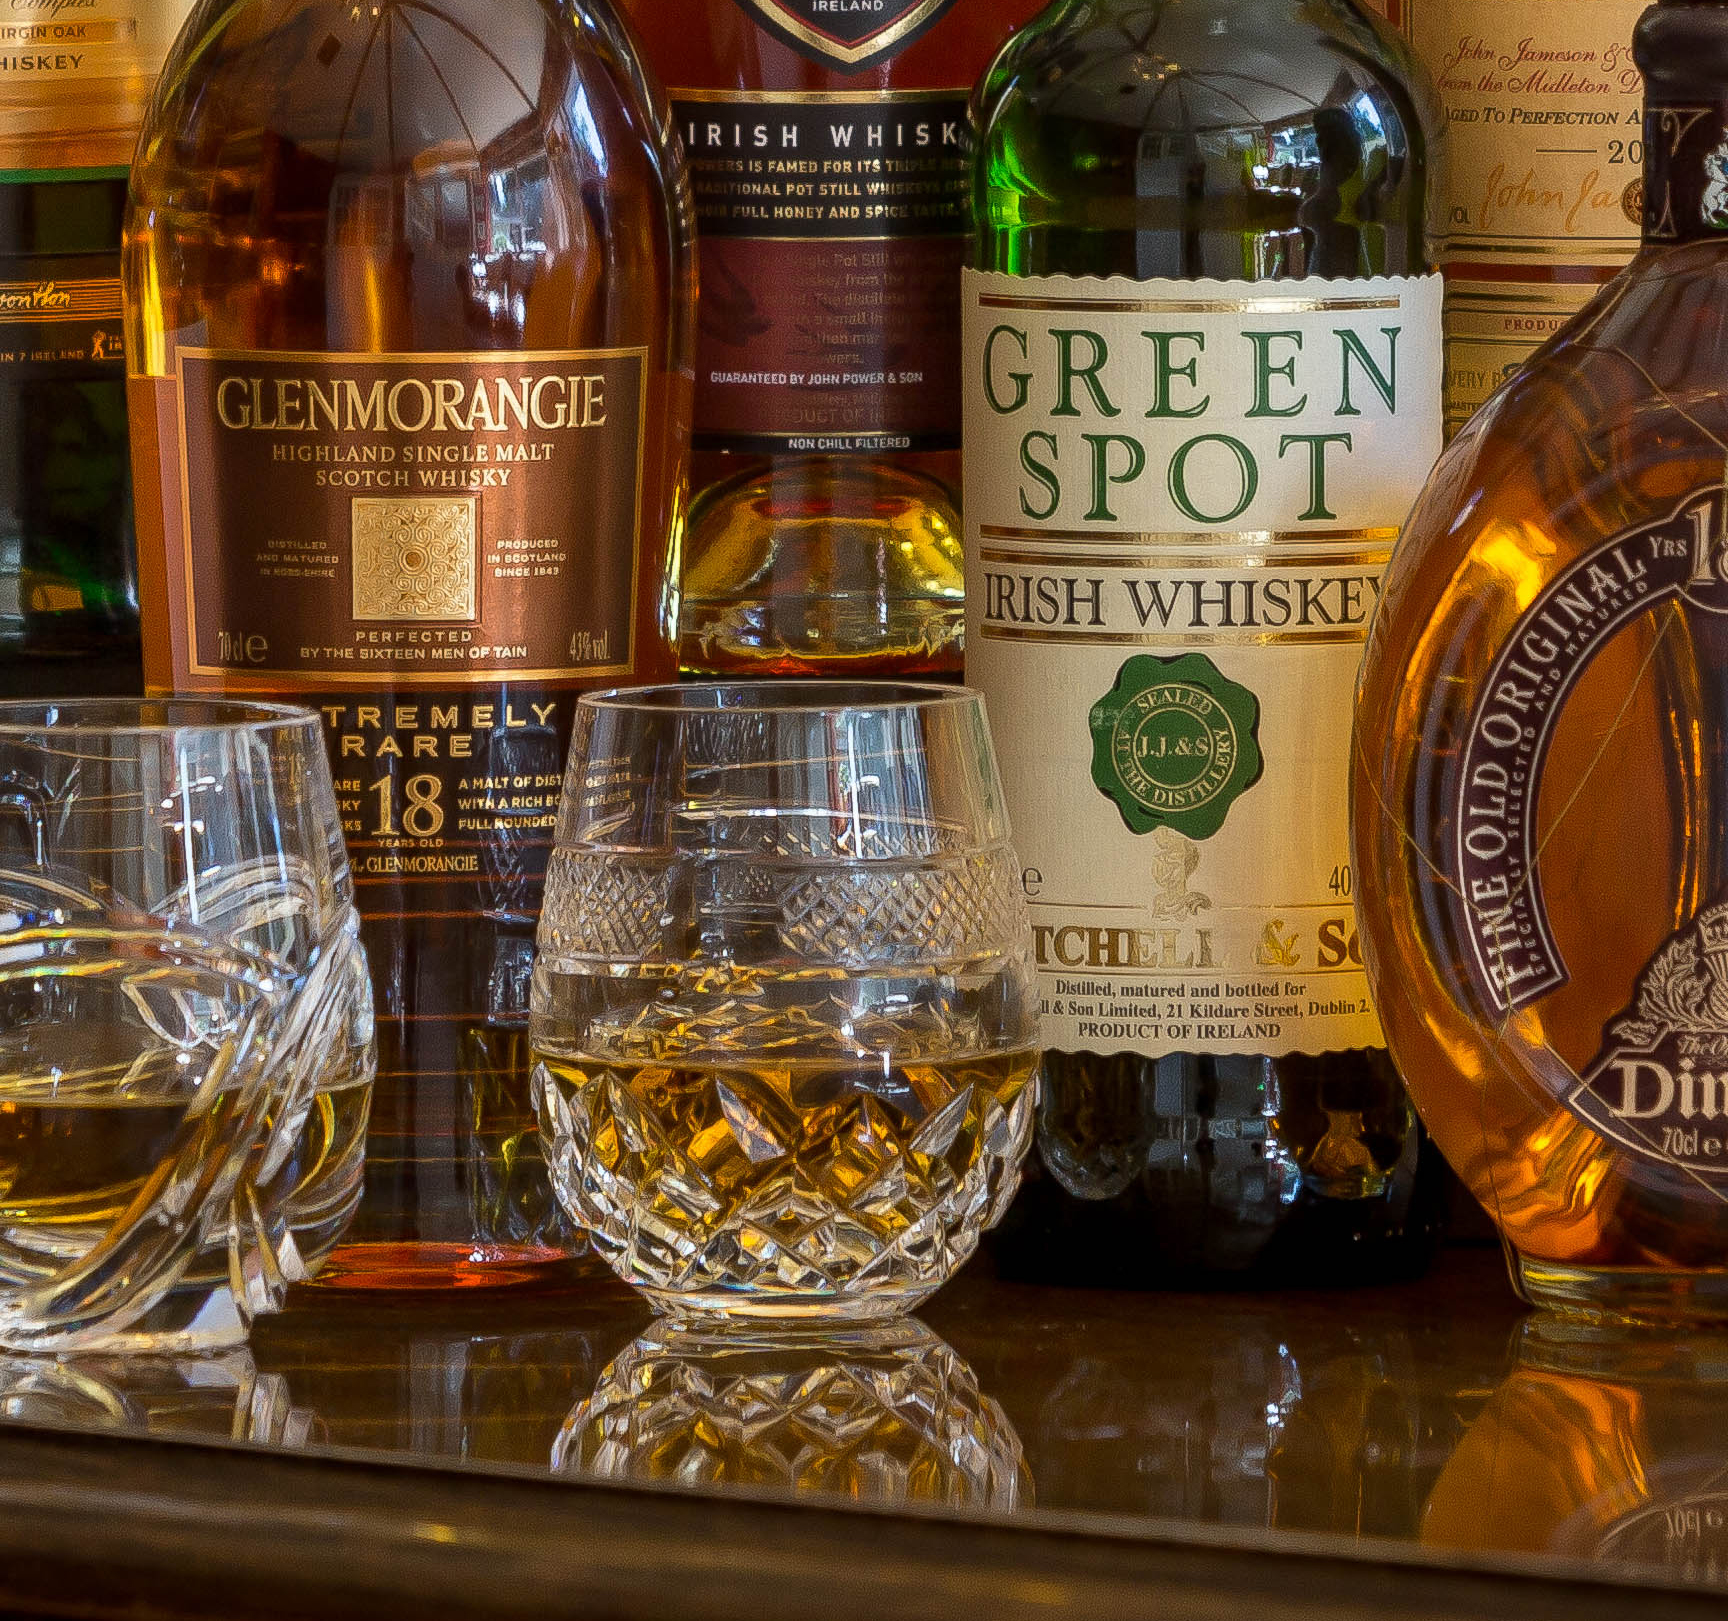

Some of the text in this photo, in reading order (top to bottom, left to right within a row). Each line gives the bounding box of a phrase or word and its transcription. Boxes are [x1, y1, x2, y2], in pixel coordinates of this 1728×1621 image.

[54, 24, 86, 38] OAK
[689, 123, 957, 147] IRISH WHISK
[983, 324, 1401, 419] GREEN
[217, 375, 607, 431] GLENMORANGIE
[273, 442, 554, 463] HIGHLAND SINGLE MALT
[789, 438, 910, 449] NON CHILL FILTERED
[316, 469, 511, 487] SCOTCH WHISKY
[1018, 431, 1353, 523] SPOT
[1649, 536, 1688, 558] YRS
[986, 573, 1105, 626] IRISH
[356, 631, 472, 643] PERFECTED
[301, 646, 527, 659] BY THE SIXTEEN MEN OF TAIN
[1137, 688, 1212, 715] SEALED
[322, 704, 556, 729] TREMELY
[341, 735, 472, 757] RARE
[1120, 759, 1147, 797] THE
[1154, 728, 1232, 806] DISTILLERY
[1466, 548, 1647, 990] FINE OLD ORIGINAL
[369, 774, 444, 837] 18
[367, 856, 478, 872] GLENMORANGIE
[1078, 1023, 1281, 1039] PRODUCT OF IRELAND
[1662, 1127, 1698, 1157] 70cl
